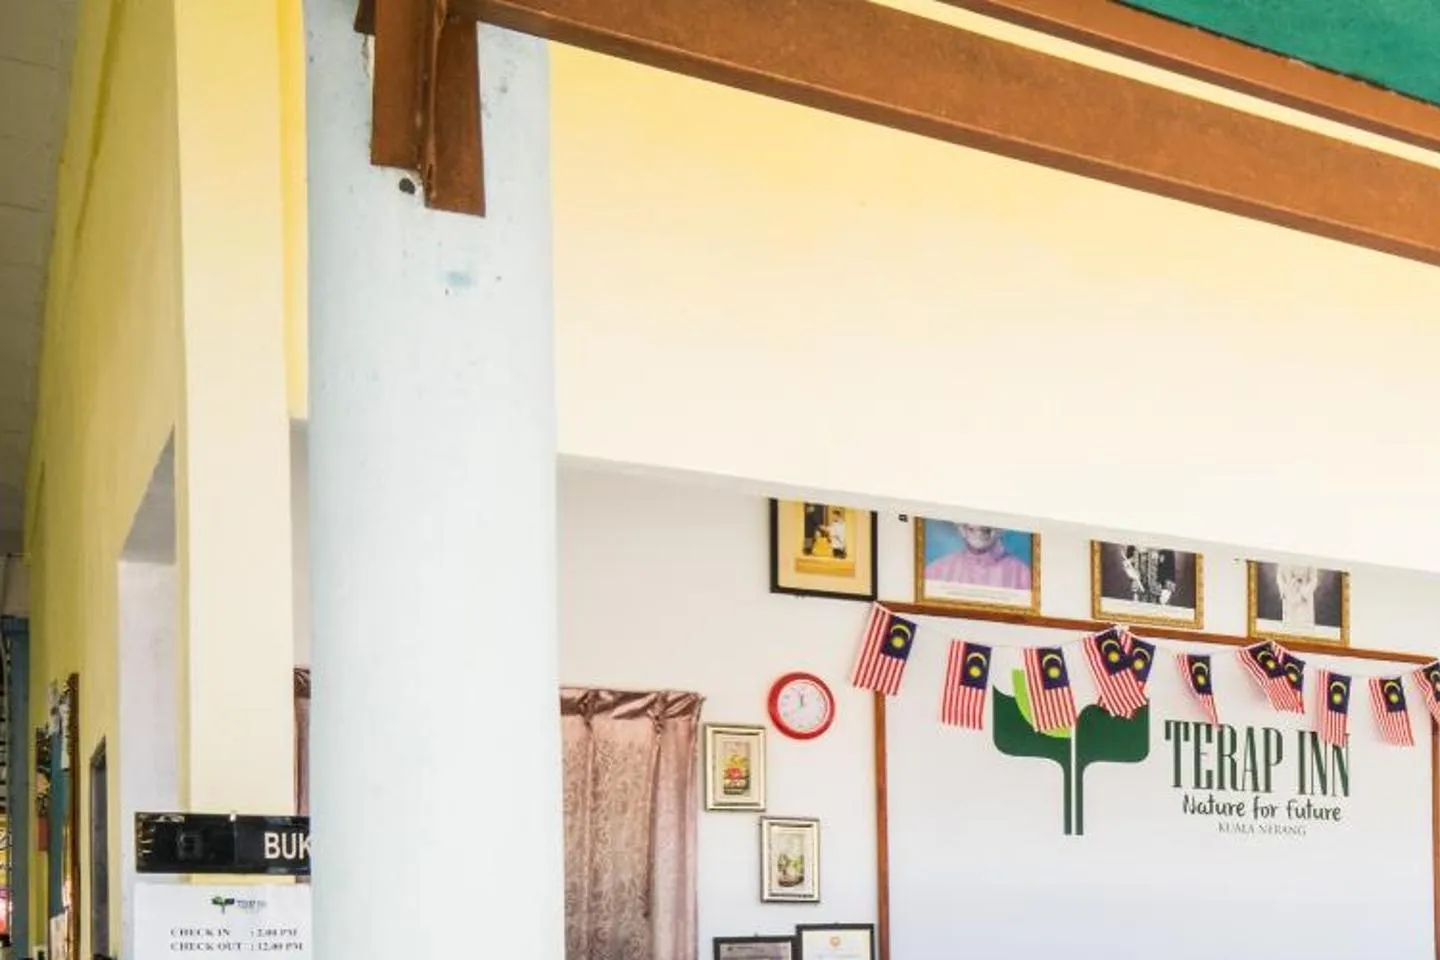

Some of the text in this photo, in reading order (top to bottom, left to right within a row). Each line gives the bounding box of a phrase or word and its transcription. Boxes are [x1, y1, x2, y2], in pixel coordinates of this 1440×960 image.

[1164, 720, 1350, 797] TERAP INN
[1183, 793, 1245, 816] Nature
[1253, 796, 1278, 820] for
[1218, 822, 1307, 836] KUALA NERANG
[170, 928, 214, 937] CHECK
[218, 928, 230, 937] IN
[280, 928, 297, 937] PM
[170, 942, 214, 951] CHECK
[218, 942, 241, 951] OUT
[285, 942, 303, 951] PM
